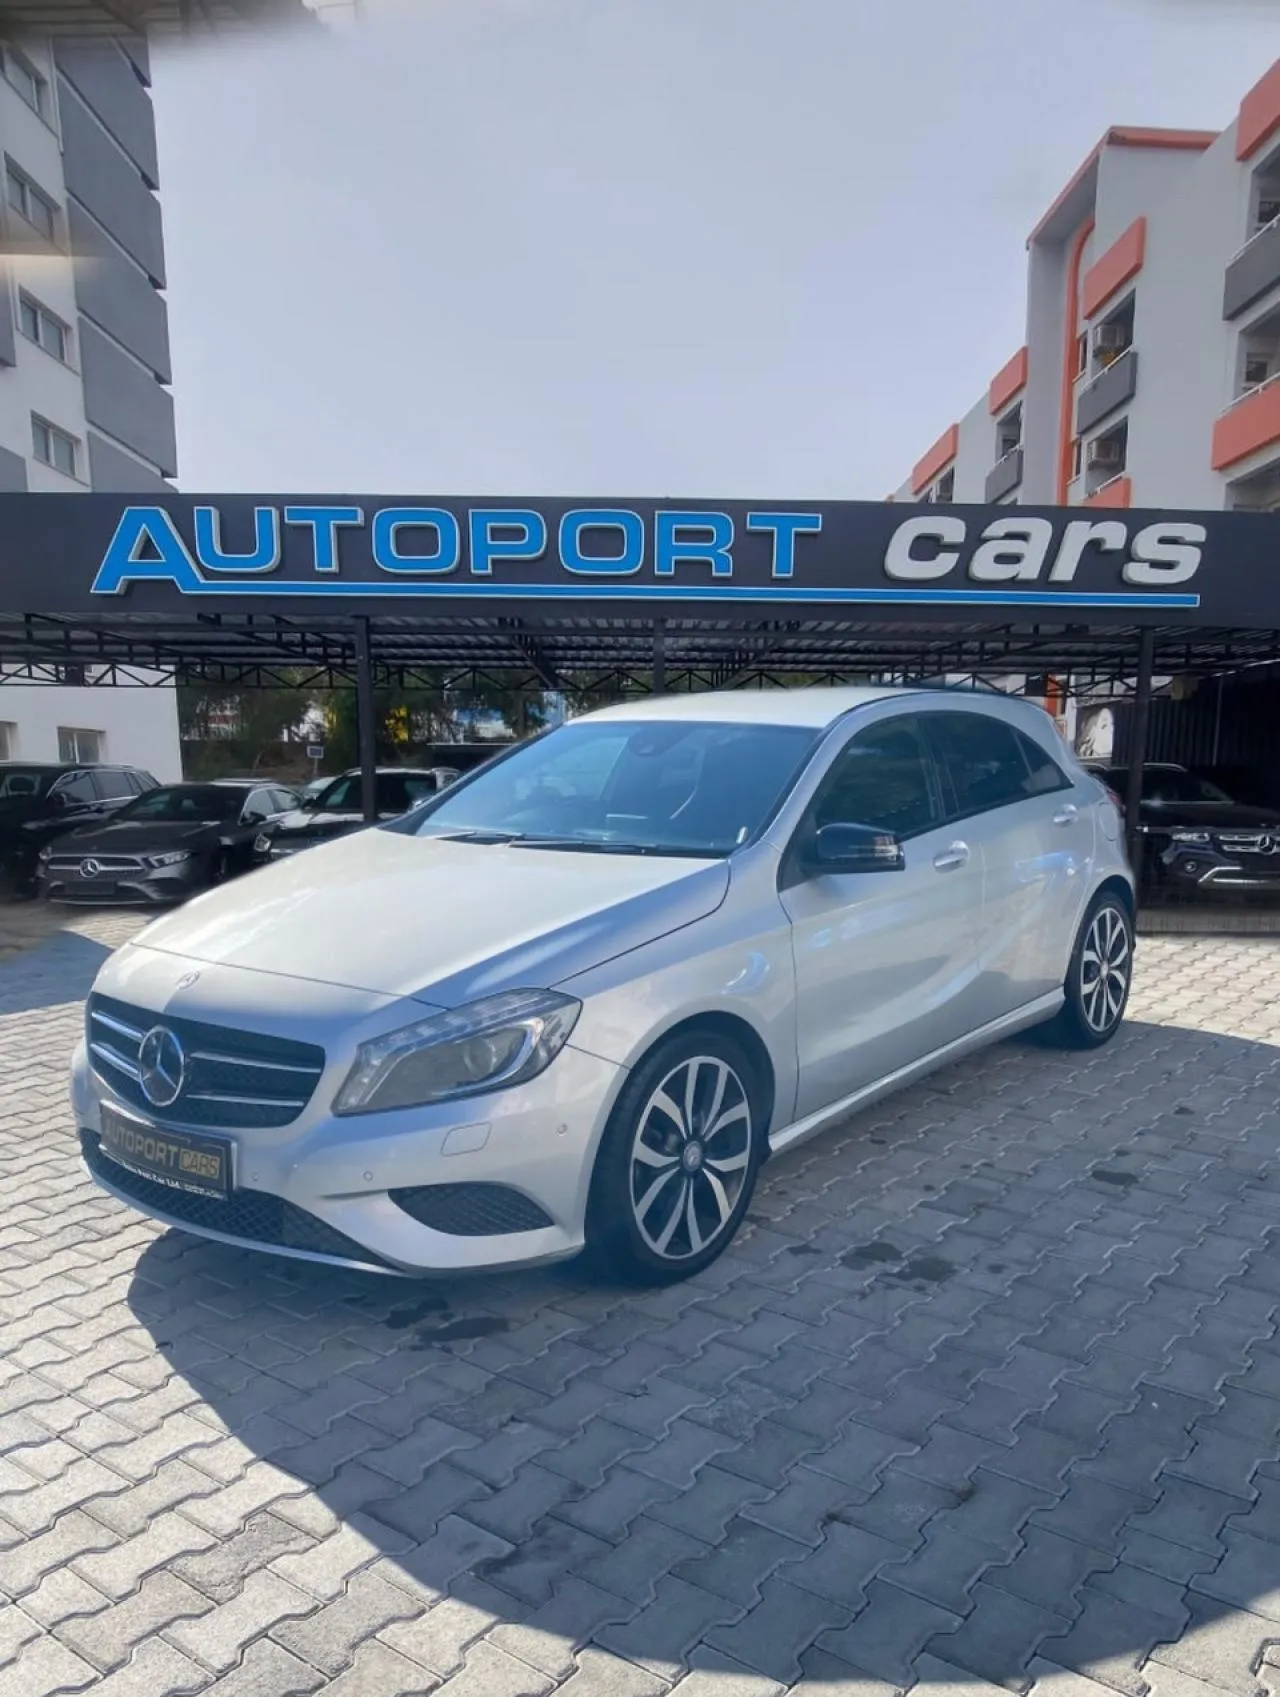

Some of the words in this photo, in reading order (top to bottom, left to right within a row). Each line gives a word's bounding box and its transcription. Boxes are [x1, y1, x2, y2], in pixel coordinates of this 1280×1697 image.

[91, 507, 823, 595] AUTOPORT
[885, 515, 1206, 585] cars
[180, 1150, 219, 1178] CARS
